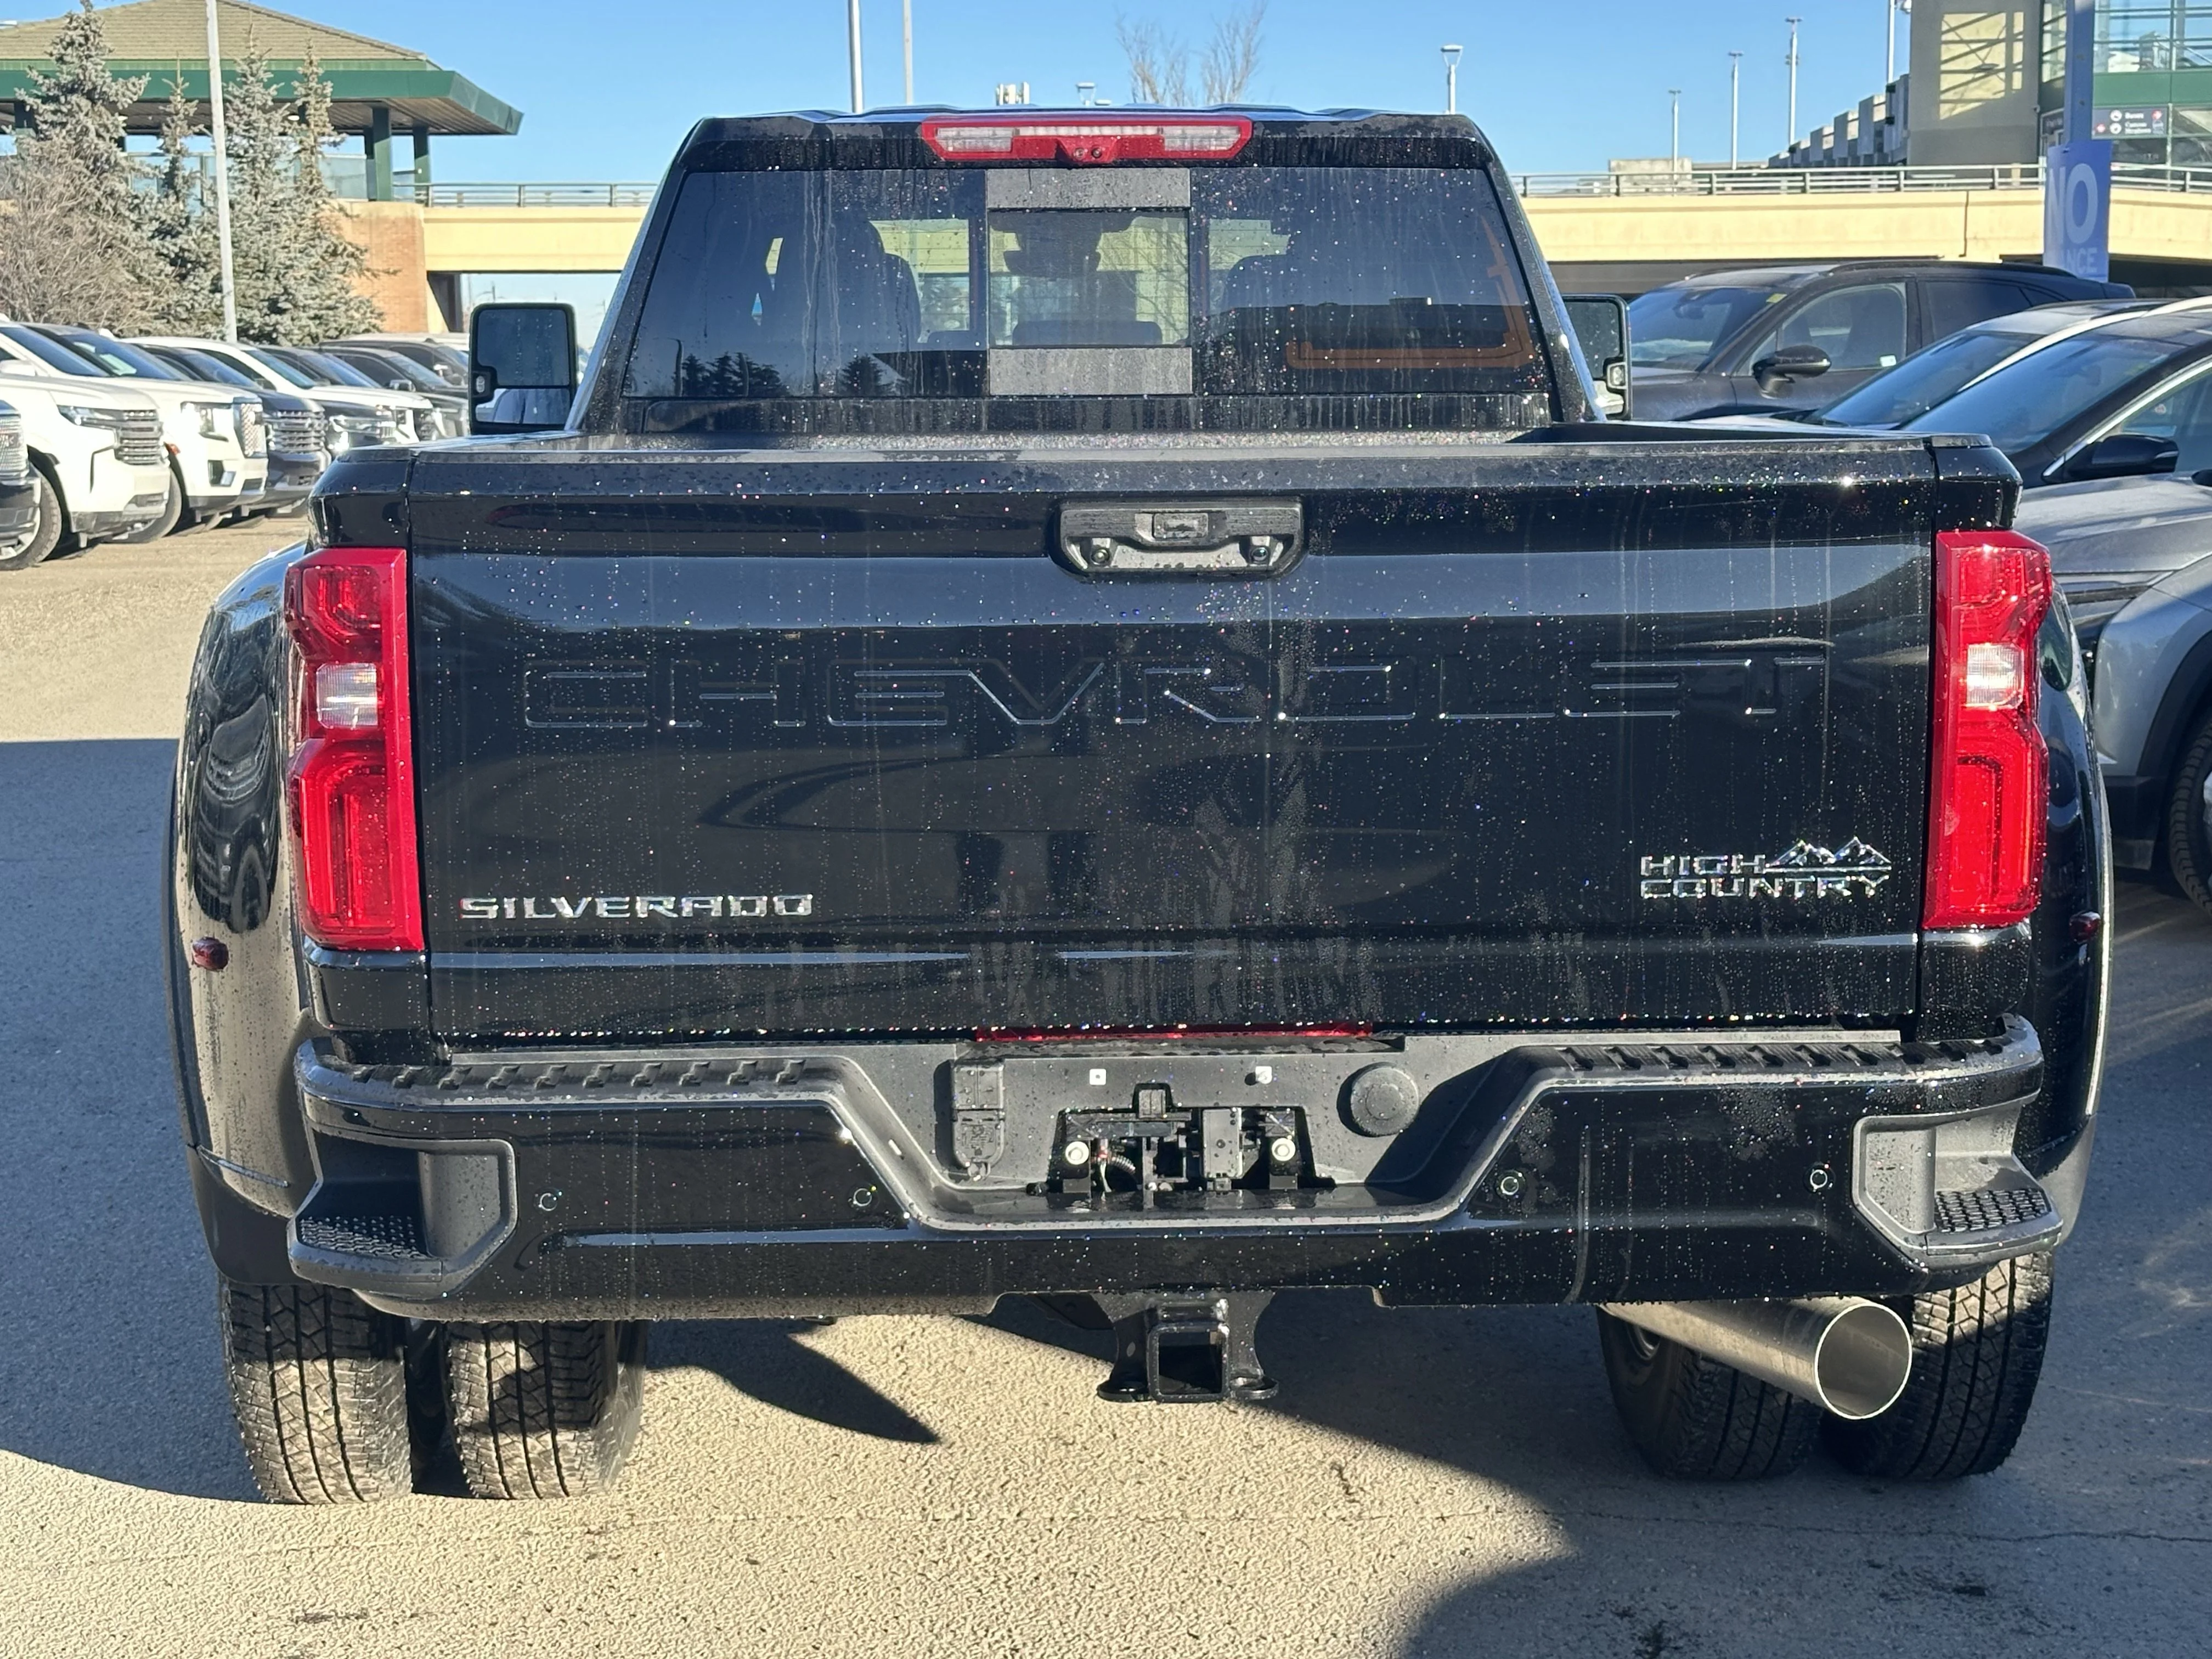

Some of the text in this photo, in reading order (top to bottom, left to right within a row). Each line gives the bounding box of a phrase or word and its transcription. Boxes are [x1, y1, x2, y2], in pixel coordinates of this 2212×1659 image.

[523, 656, 1826, 729] CHEVROLET
[1641, 854, 1766, 876] HIGH
[1641, 876, 1888, 898] COUNTRY
[460, 895, 812, 919] SILVERADO
